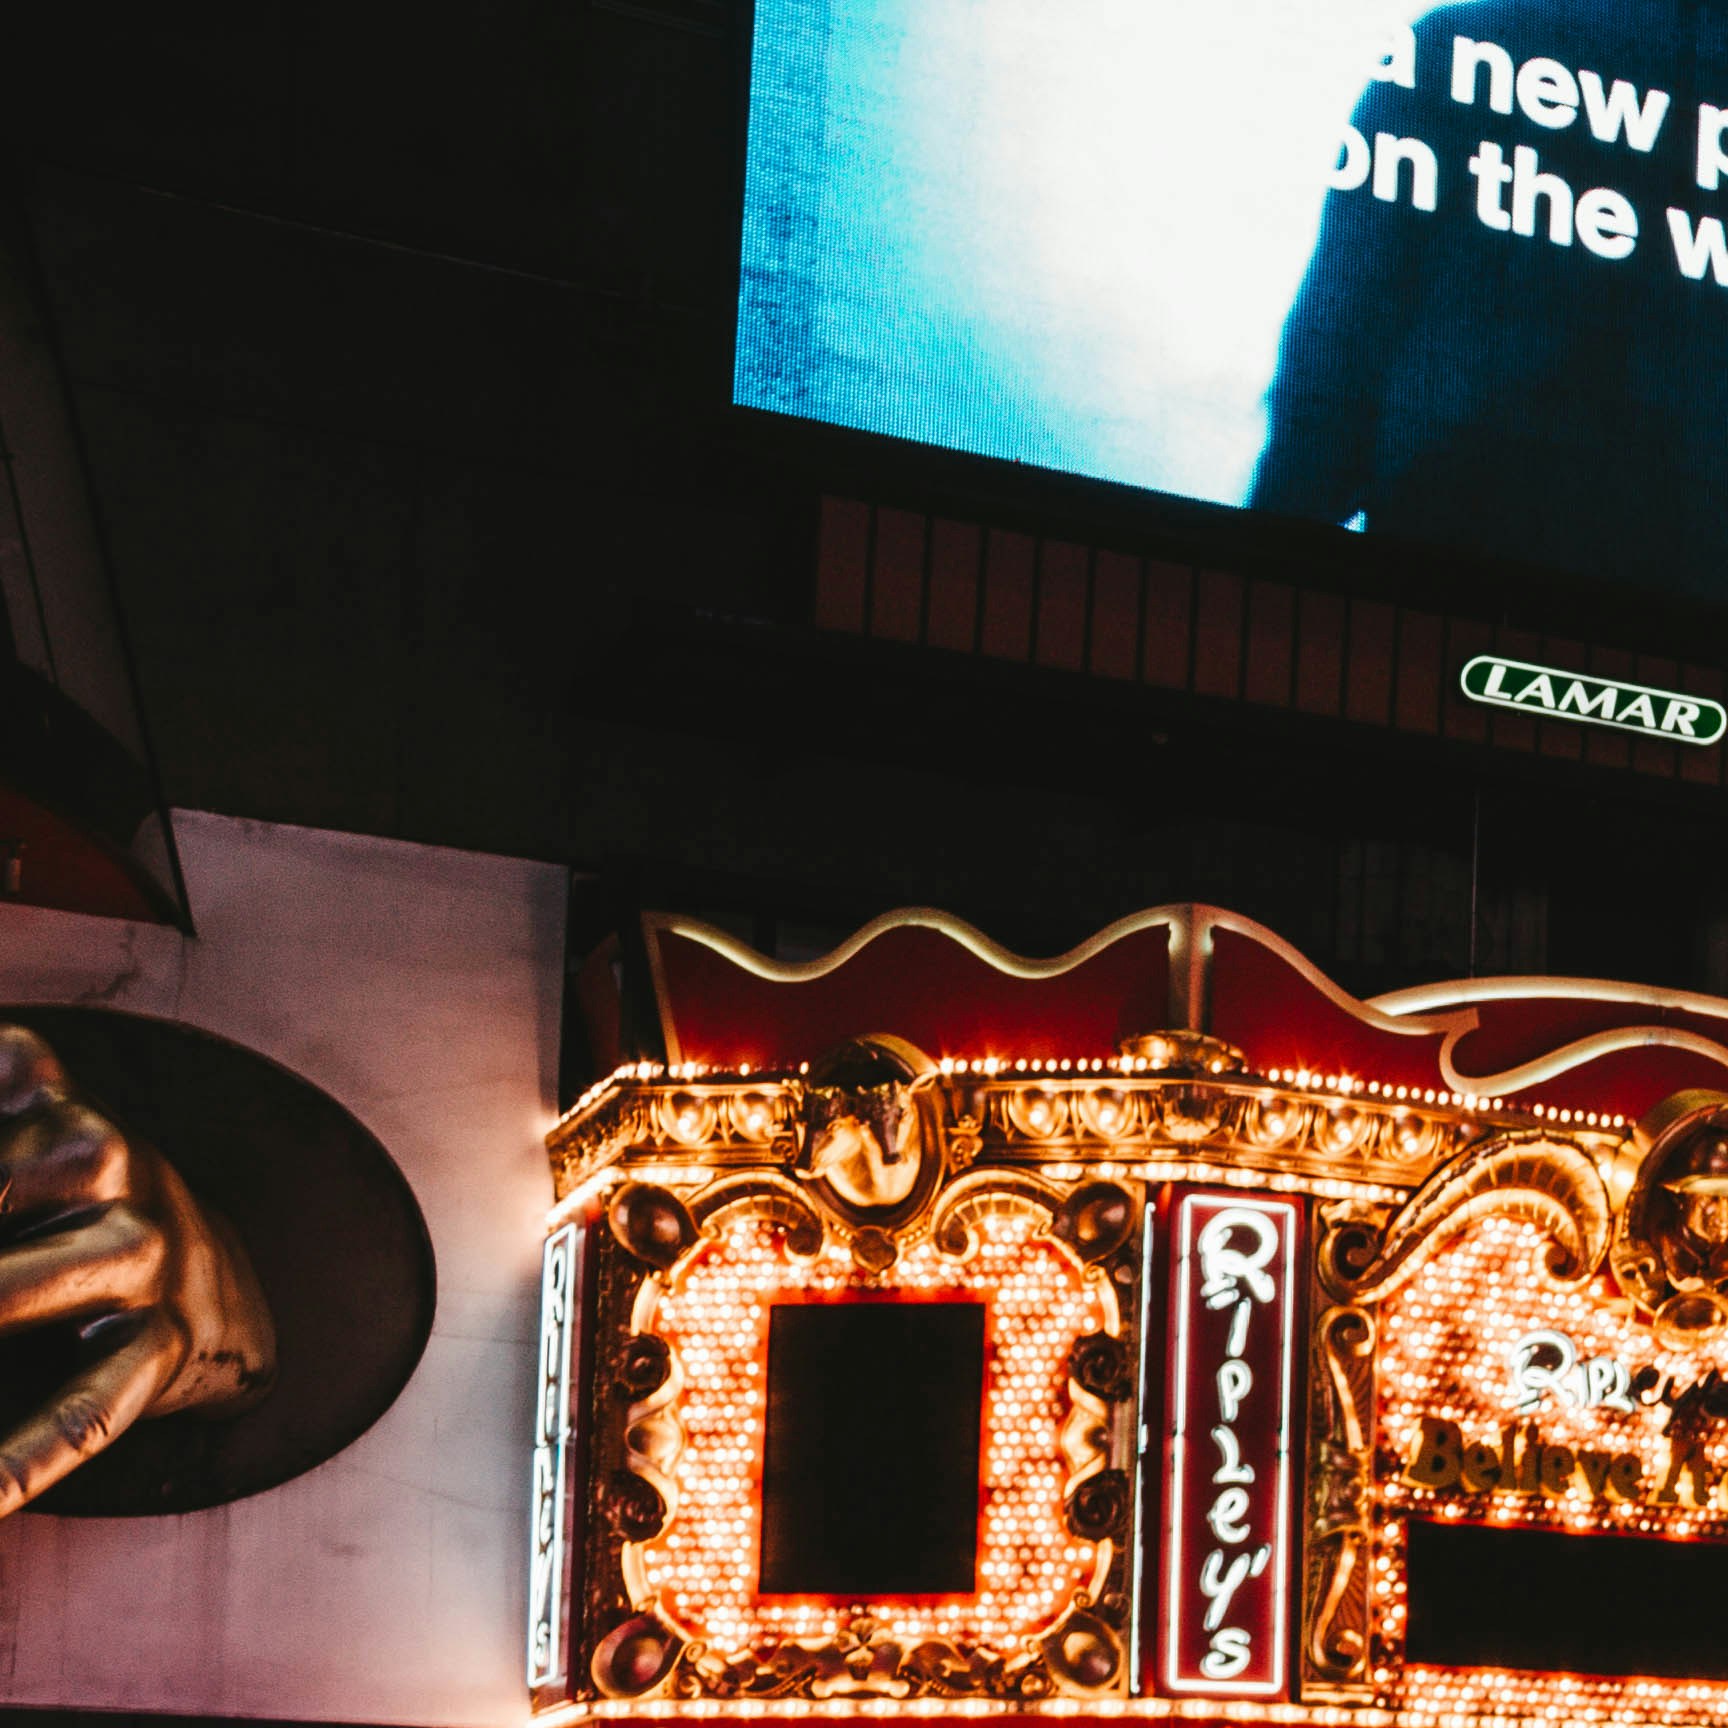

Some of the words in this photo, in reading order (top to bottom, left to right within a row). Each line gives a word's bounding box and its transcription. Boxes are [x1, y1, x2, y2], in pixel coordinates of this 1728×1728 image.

[1450, 29, 1667, 153] new
[1327, 122, 1437, 213] on
[1470, 142, 1637, 259] the
[1483, 663, 1702, 738] LAMAR
[1198, 1207, 1280, 1678] Ripley's
[1400, 1416, 1645, 1500] Believe
[1647, 1432, 1713, 1507] It
